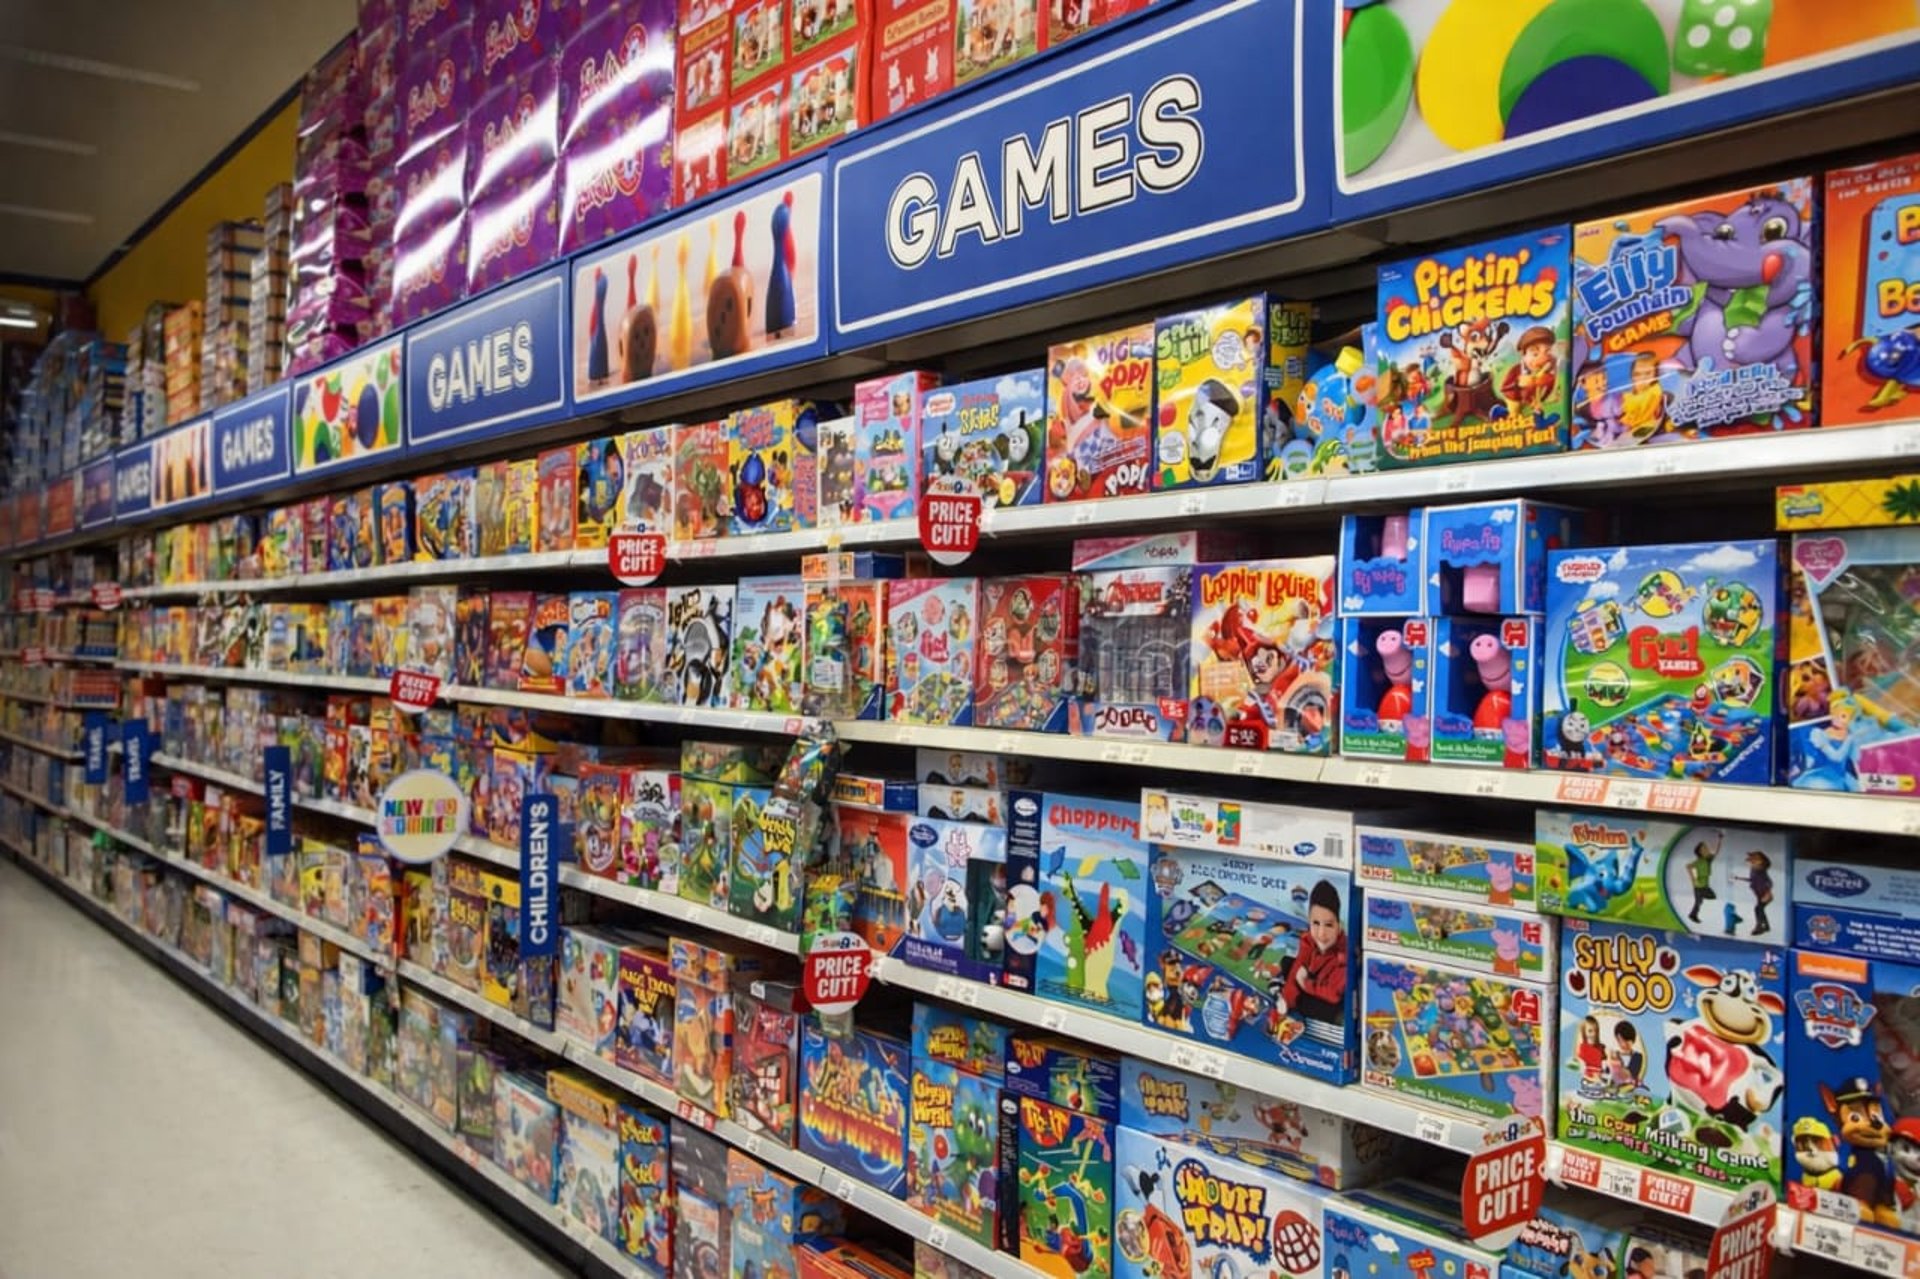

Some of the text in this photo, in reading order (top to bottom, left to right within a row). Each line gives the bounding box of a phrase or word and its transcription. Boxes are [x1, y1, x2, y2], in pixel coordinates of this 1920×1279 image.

[887, 73, 1204, 270] GAMES
[1414, 249, 1530, 304] Pickin'
[1579, 246, 1677, 314] Elly
[1585, 285, 1692, 342] Fountain
[1609, 312, 1672, 351] GAME
[428, 321, 533, 413] GAMES
[1100, 361, 1149, 400] POP!
[222, 416, 274, 472] GAMES
[117, 460, 151, 502] GAMES
[1105, 462, 1149, 495] POP!
[929, 502, 973, 522] PRICE
[617, 537, 658, 555] PRICE
[931, 523, 970, 546] CUT!
[620, 555, 655, 573] CUT!
[1202, 568, 1262, 606] Loopin'
[1266, 570, 1318, 606] Louie
[269, 769, 285, 831] FAMILY
[385, 800, 423, 816] NEW
[1048, 803, 1141, 841] Choppers
[530, 802, 548, 944] CHILDREN'S
[815, 956, 862, 977] PRICE
[1575, 934, 1656, 975] SILLY
[817, 977, 858, 999] CUT!
[1591, 971, 1674, 1011] MOO
[1646, 1126, 1709, 1163] Milking
[1716, 1146, 1769, 1169] Game
[1475, 1148, 1535, 1195] PRICE
[1478, 1180, 1529, 1225] CUT!
[1718, 1215, 1766, 1264] PRICE
